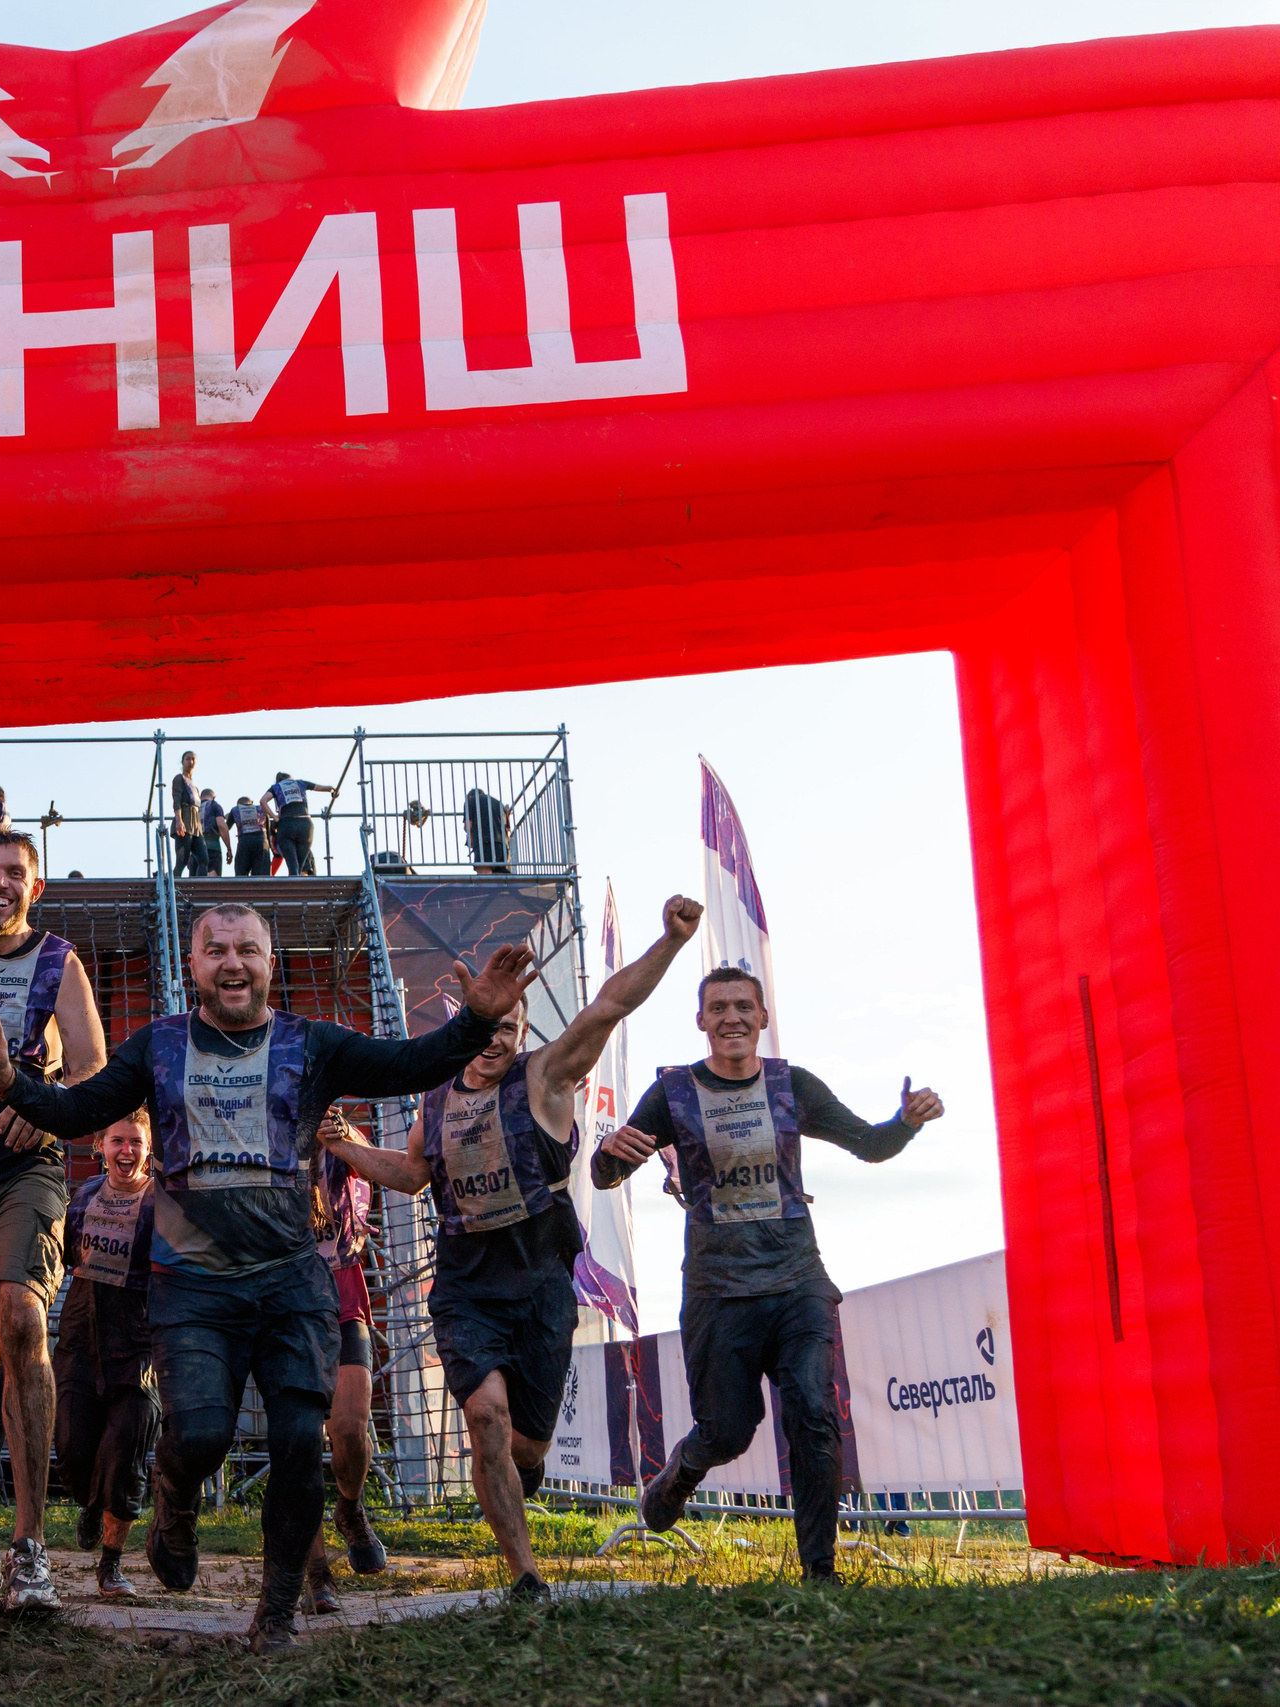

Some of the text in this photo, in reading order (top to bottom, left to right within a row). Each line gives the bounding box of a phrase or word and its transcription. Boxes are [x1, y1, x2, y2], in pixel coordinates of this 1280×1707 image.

[189, 1074, 263, 1085] ГОНКА ГЕРОЕВ
[198, 1096, 252, 1110] КОМНДНЫЙ
[705, 1101, 766, 1116] ГОНКА ГЕРОЕВ
[446, 1110, 469, 1120] ГОНКА
[450, 1120, 491, 1139] КОМАНДНЫЙ
[715, 1118, 763, 1133] КОМАНДНЫЙ
[461, 1135, 483, 1147] СТАРТ
[730, 1129, 752, 1139] СТАРТ
[453, 1167, 510, 1200] 04307
[715, 1163, 775, 1189] 04310
[476, 1203, 522, 1221] ГАЗПРОМБАНК
[82, 1233, 130, 1258] 04304
[887, 1373, 996, 1419] Северсталь
[556, 1437, 582, 1448] МИНСПОРТ
[560, 1454, 581, 1466] РОССИИ
